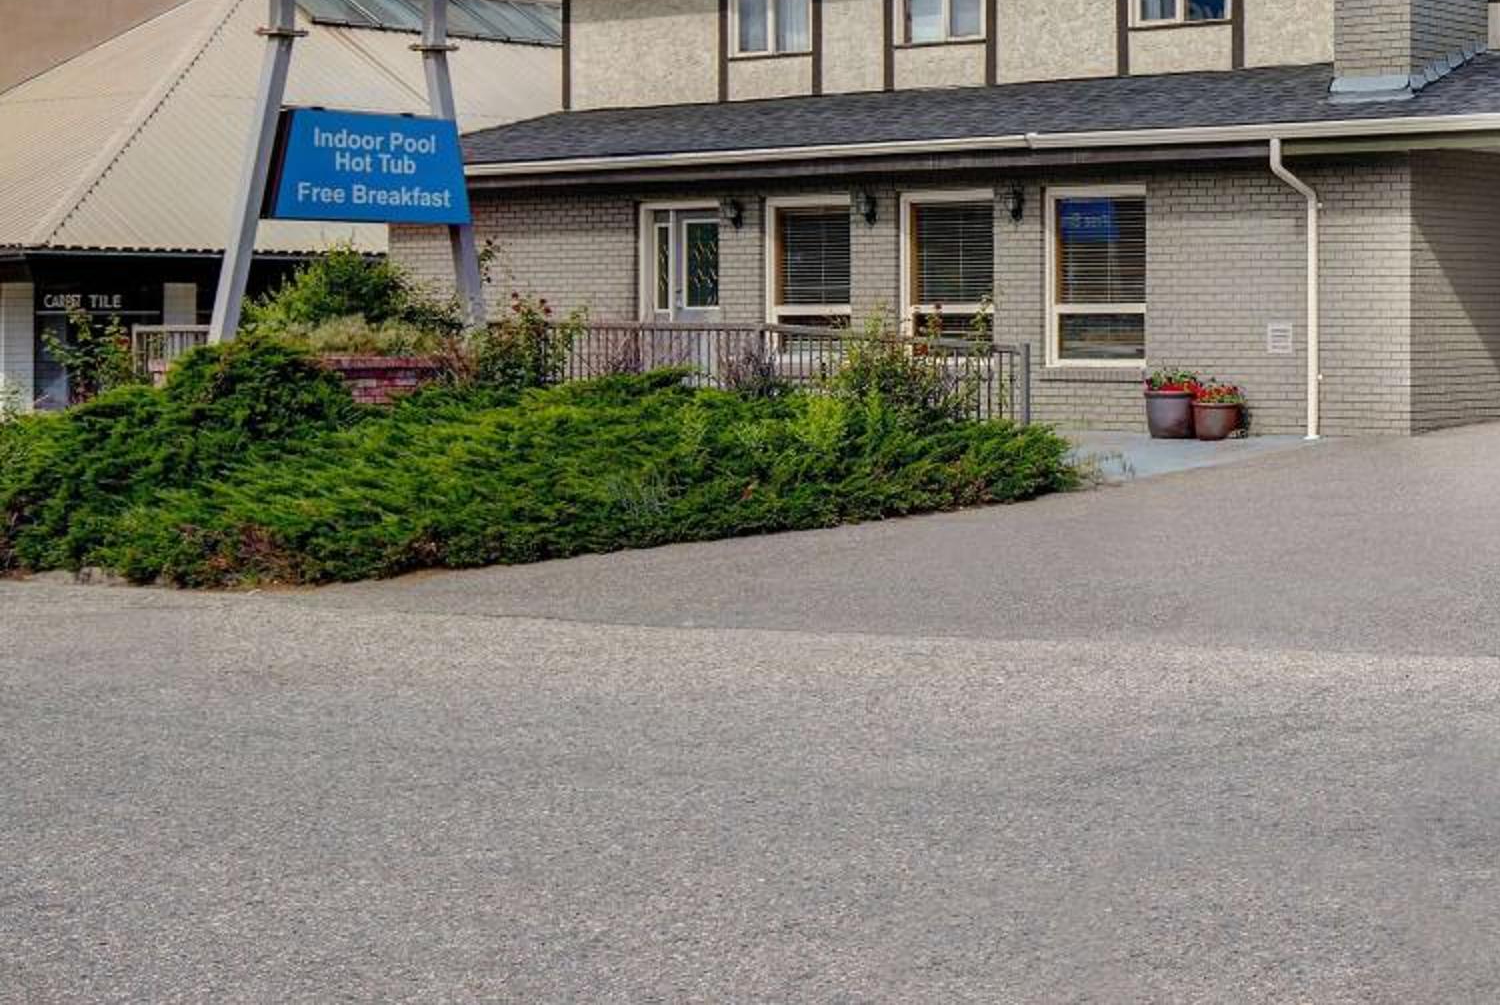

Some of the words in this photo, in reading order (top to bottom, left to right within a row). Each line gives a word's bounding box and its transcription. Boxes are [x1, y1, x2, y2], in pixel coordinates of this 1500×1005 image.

[313, 127, 385, 150] Indoor
[389, 132, 436, 154] Pool
[335, 151, 372, 173] Hot
[378, 153, 416, 175] Tub
[297, 181, 345, 202] Free
[352, 184, 451, 208] Breakfast
[88, 294, 122, 308] TILE
